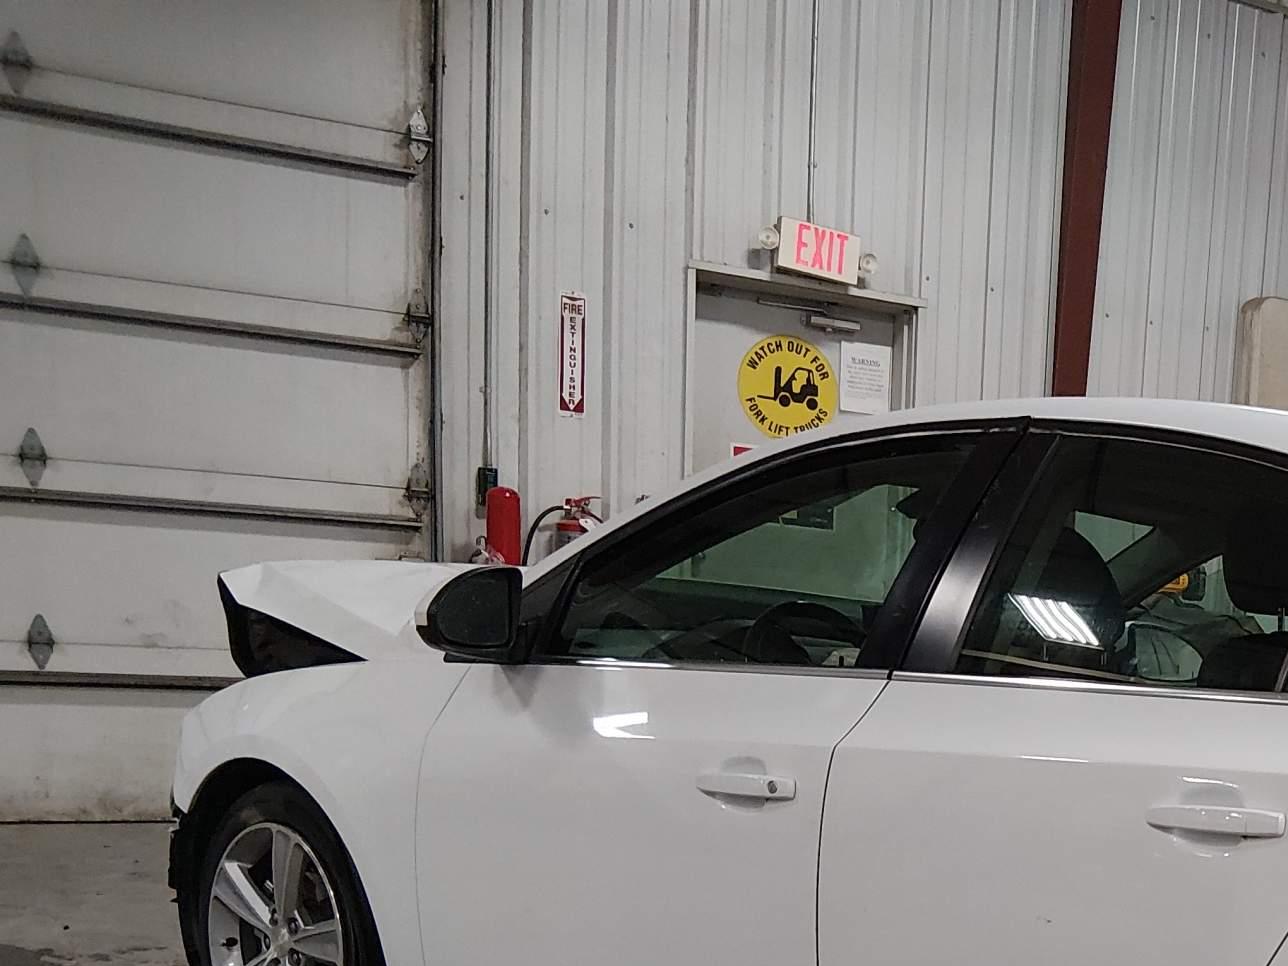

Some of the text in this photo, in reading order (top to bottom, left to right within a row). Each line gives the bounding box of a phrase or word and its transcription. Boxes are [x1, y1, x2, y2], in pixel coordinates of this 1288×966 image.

[796, 223, 848, 275] EXIT
[563, 303, 583, 316] FIRE
[568, 316, 577, 405] EXTINGUISHER
[746, 340, 830, 381] WATCH OUT FOR
[746, 397, 769, 426] FORK
[768, 420, 791, 437] LIFT
